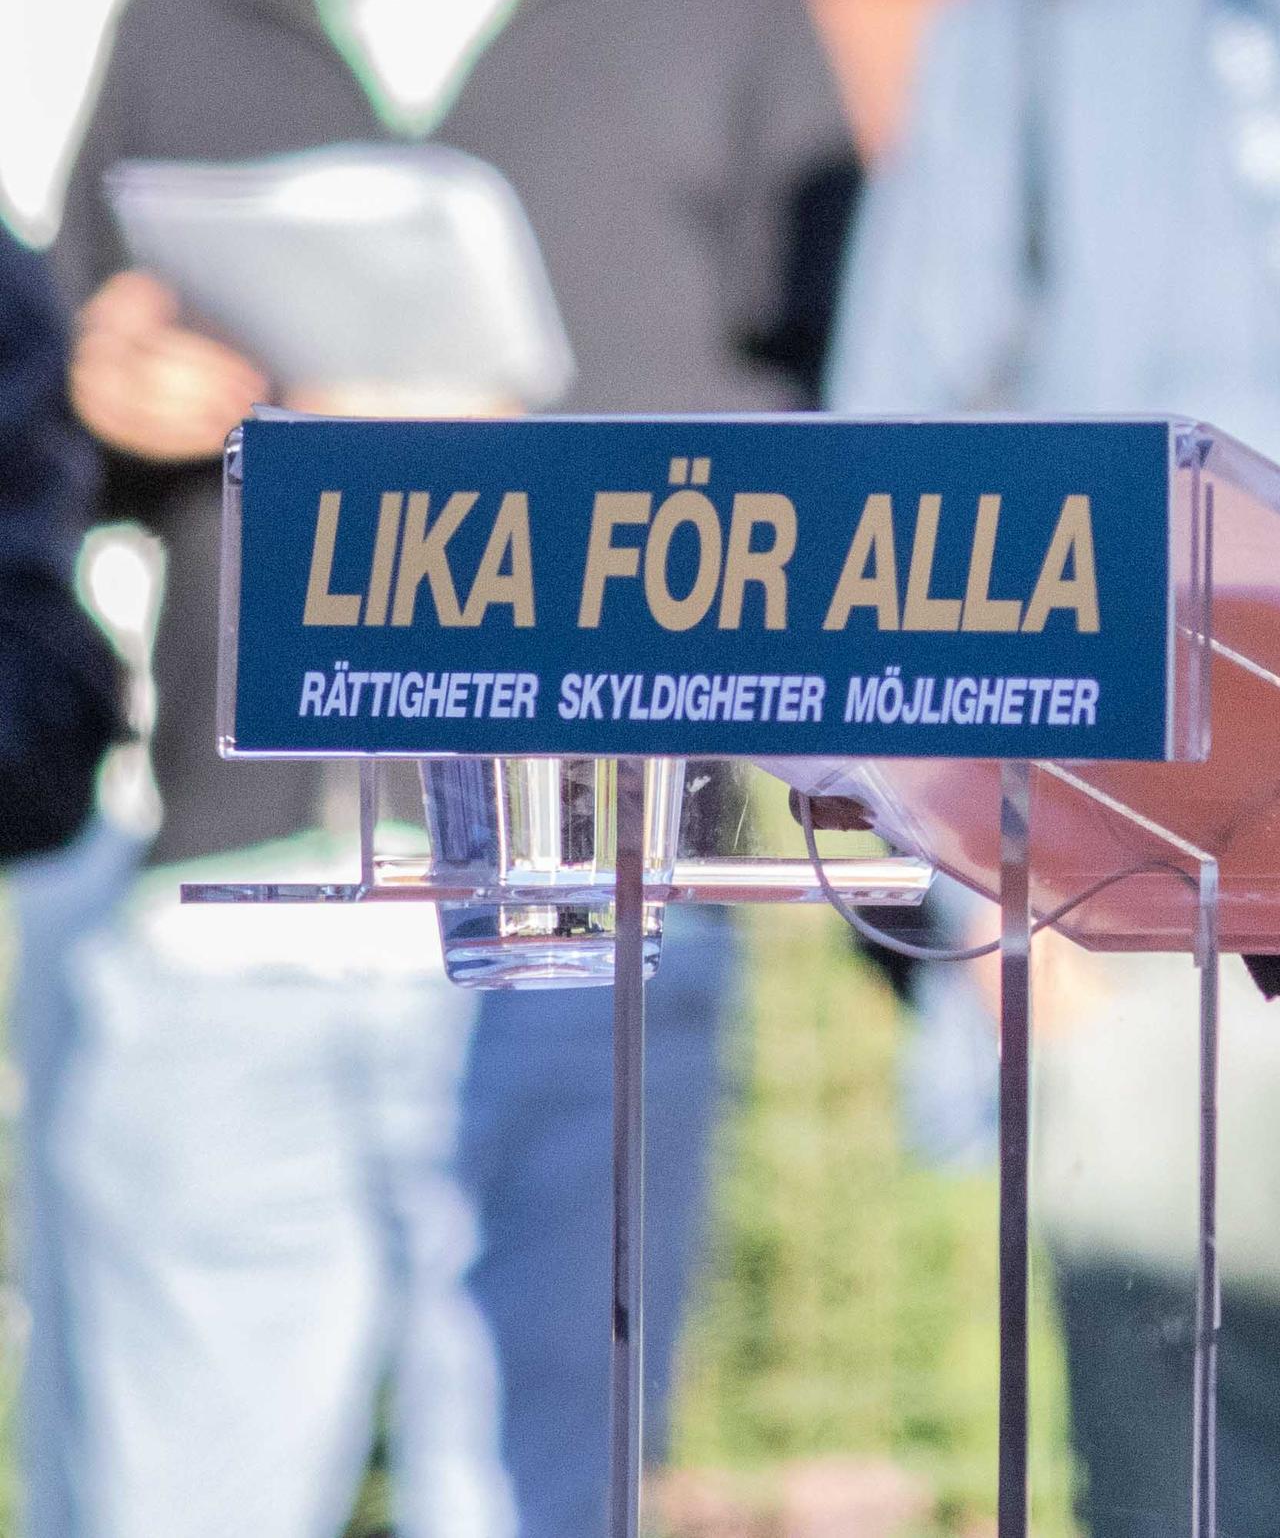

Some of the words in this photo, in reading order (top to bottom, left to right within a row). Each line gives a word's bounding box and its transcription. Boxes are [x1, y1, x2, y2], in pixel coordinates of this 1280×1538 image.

[303, 492, 536, 628] LIKA
[577, 458, 798, 632] FÖR
[823, 494, 1100, 633] ALLA
[299, 661, 539, 719] RÄTTIGHETER
[558, 673, 826, 723] SKYLDIGHETER
[844, 667, 1100, 726] MÖJLIGHETER
